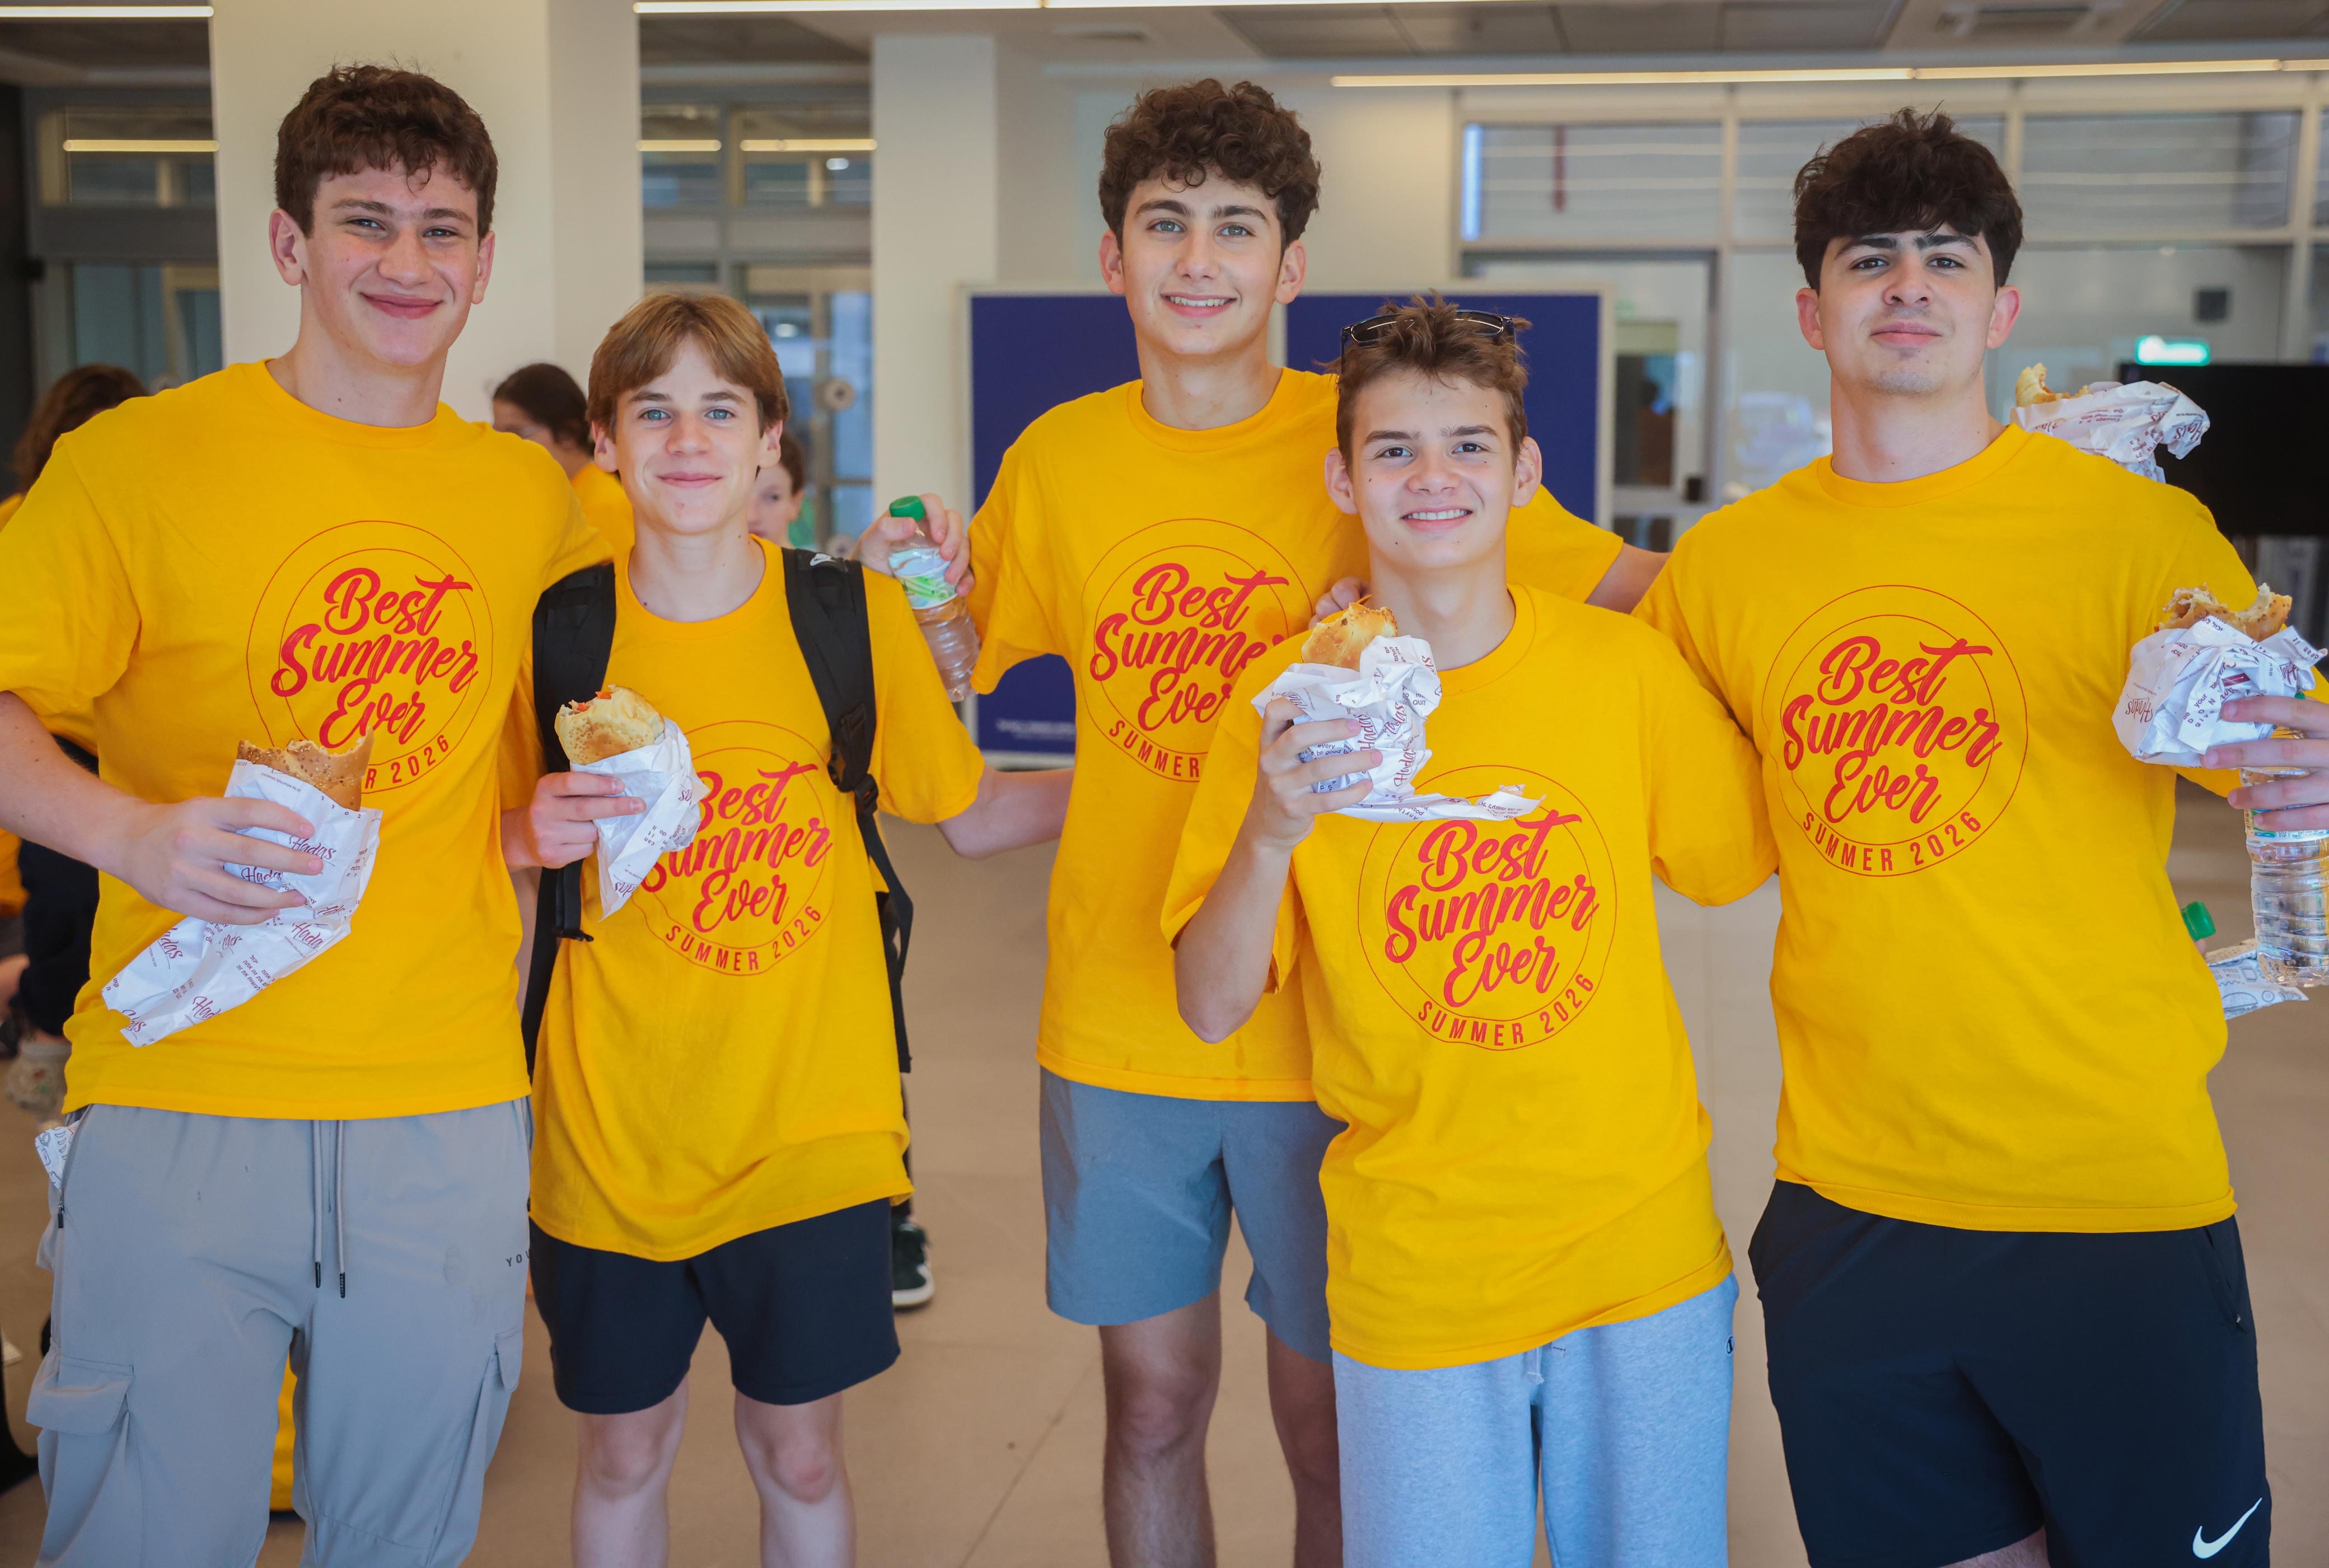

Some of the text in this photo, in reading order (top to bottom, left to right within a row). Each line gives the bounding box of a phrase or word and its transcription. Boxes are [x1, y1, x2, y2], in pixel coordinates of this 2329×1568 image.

[324, 567, 473, 636] Best
[1131, 563, 1289, 631] Best
[270, 624, 479, 697] Summer
[1089, 613, 1284, 681] Summe
[1817, 635, 1993, 706] Best
[319, 677, 425, 749] Ever
[1783, 694, 2003, 771] Summer
[2125, 698, 2153, 724] Hadas
[2194, 694, 2208, 709] your
[391, 734, 449, 784] 2026
[1109, 720, 1200, 778] SUMMER
[1824, 750, 1942, 823] Ever
[241, 866, 283, 883] Hada
[289, 835, 336, 860] Hadas
[644, 837, 655, 846] can
[1418, 809, 1582, 892] Best
[1803, 812, 1981, 871] SUMMER 2026
[615, 882, 639, 897] das
[693, 865, 790, 933] Ever
[1385, 874, 1600, 963] Summer
[292, 923, 323, 949] Hada
[666, 906, 821, 972] SUMMER 2026
[1443, 931, 1560, 1008] Ever
[193, 996, 221, 1020] Had
[1418, 973, 1594, 1046] SUMMER 2026
